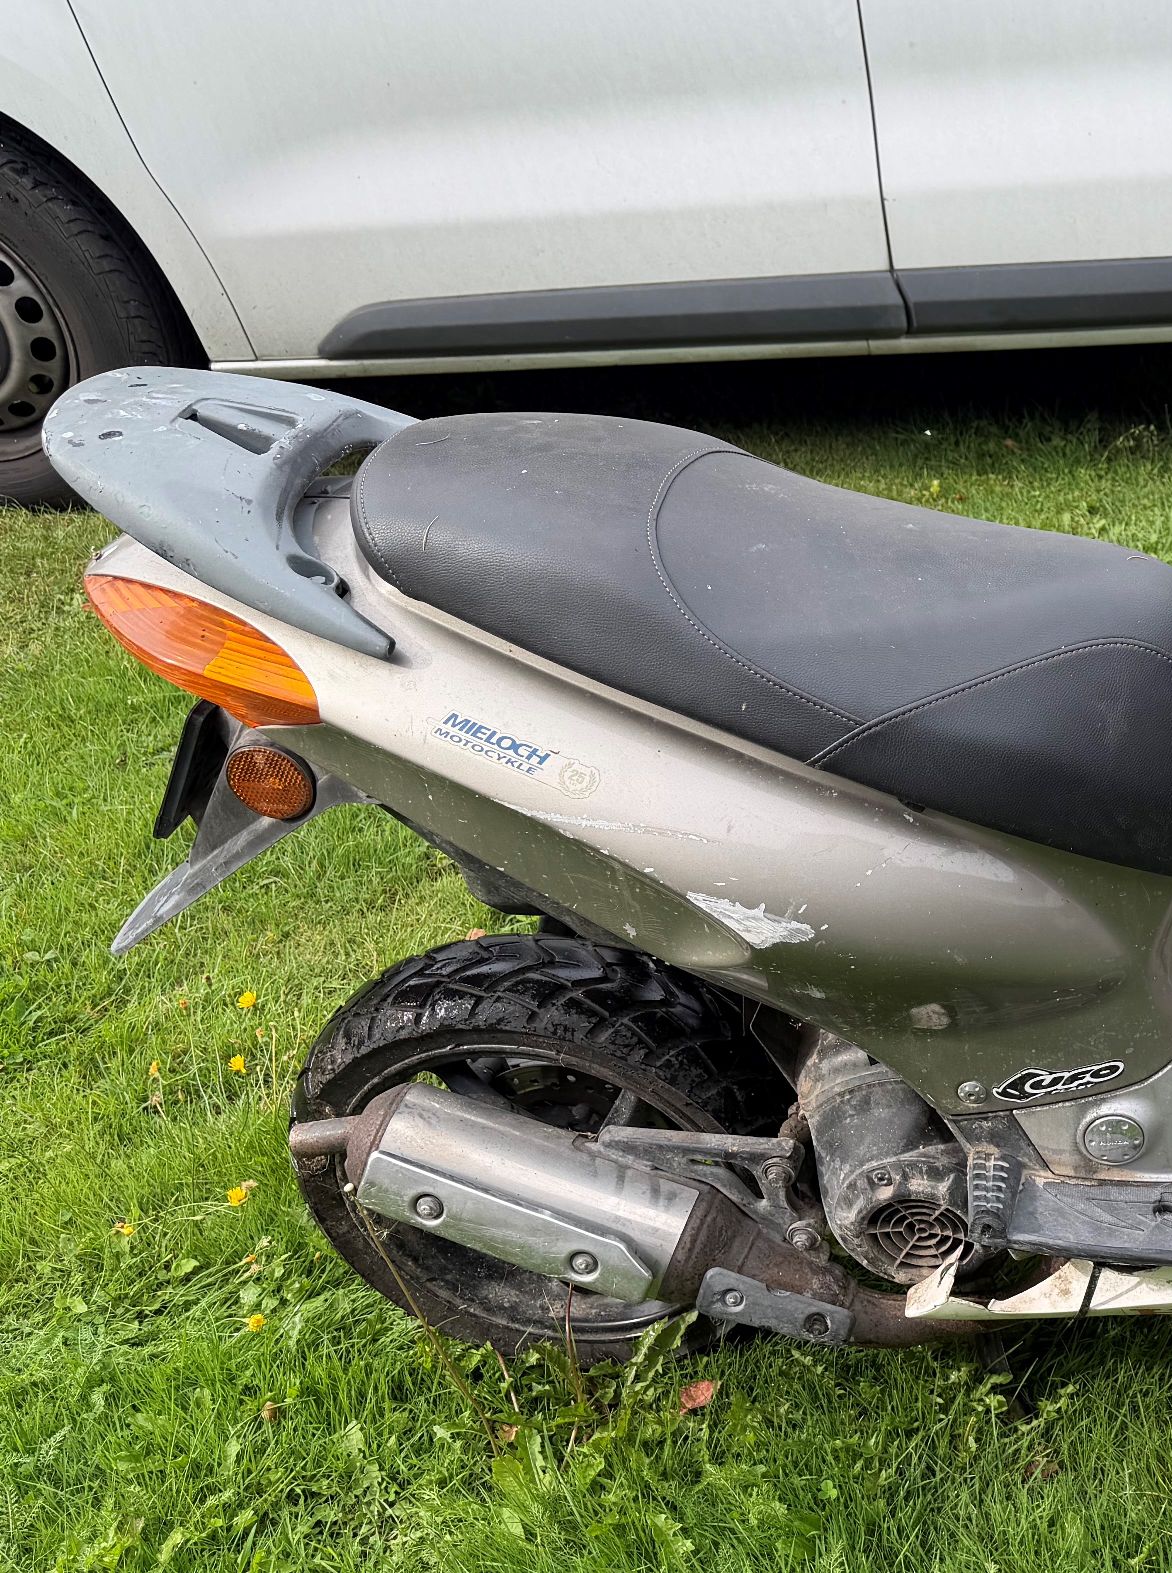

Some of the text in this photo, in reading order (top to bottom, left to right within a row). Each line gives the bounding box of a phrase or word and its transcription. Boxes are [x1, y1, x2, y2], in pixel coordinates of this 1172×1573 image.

[434, 727, 537, 776] MOTOCYKLE
[443, 712, 551, 766] MIELOCH
[568, 769, 588, 785] 25
